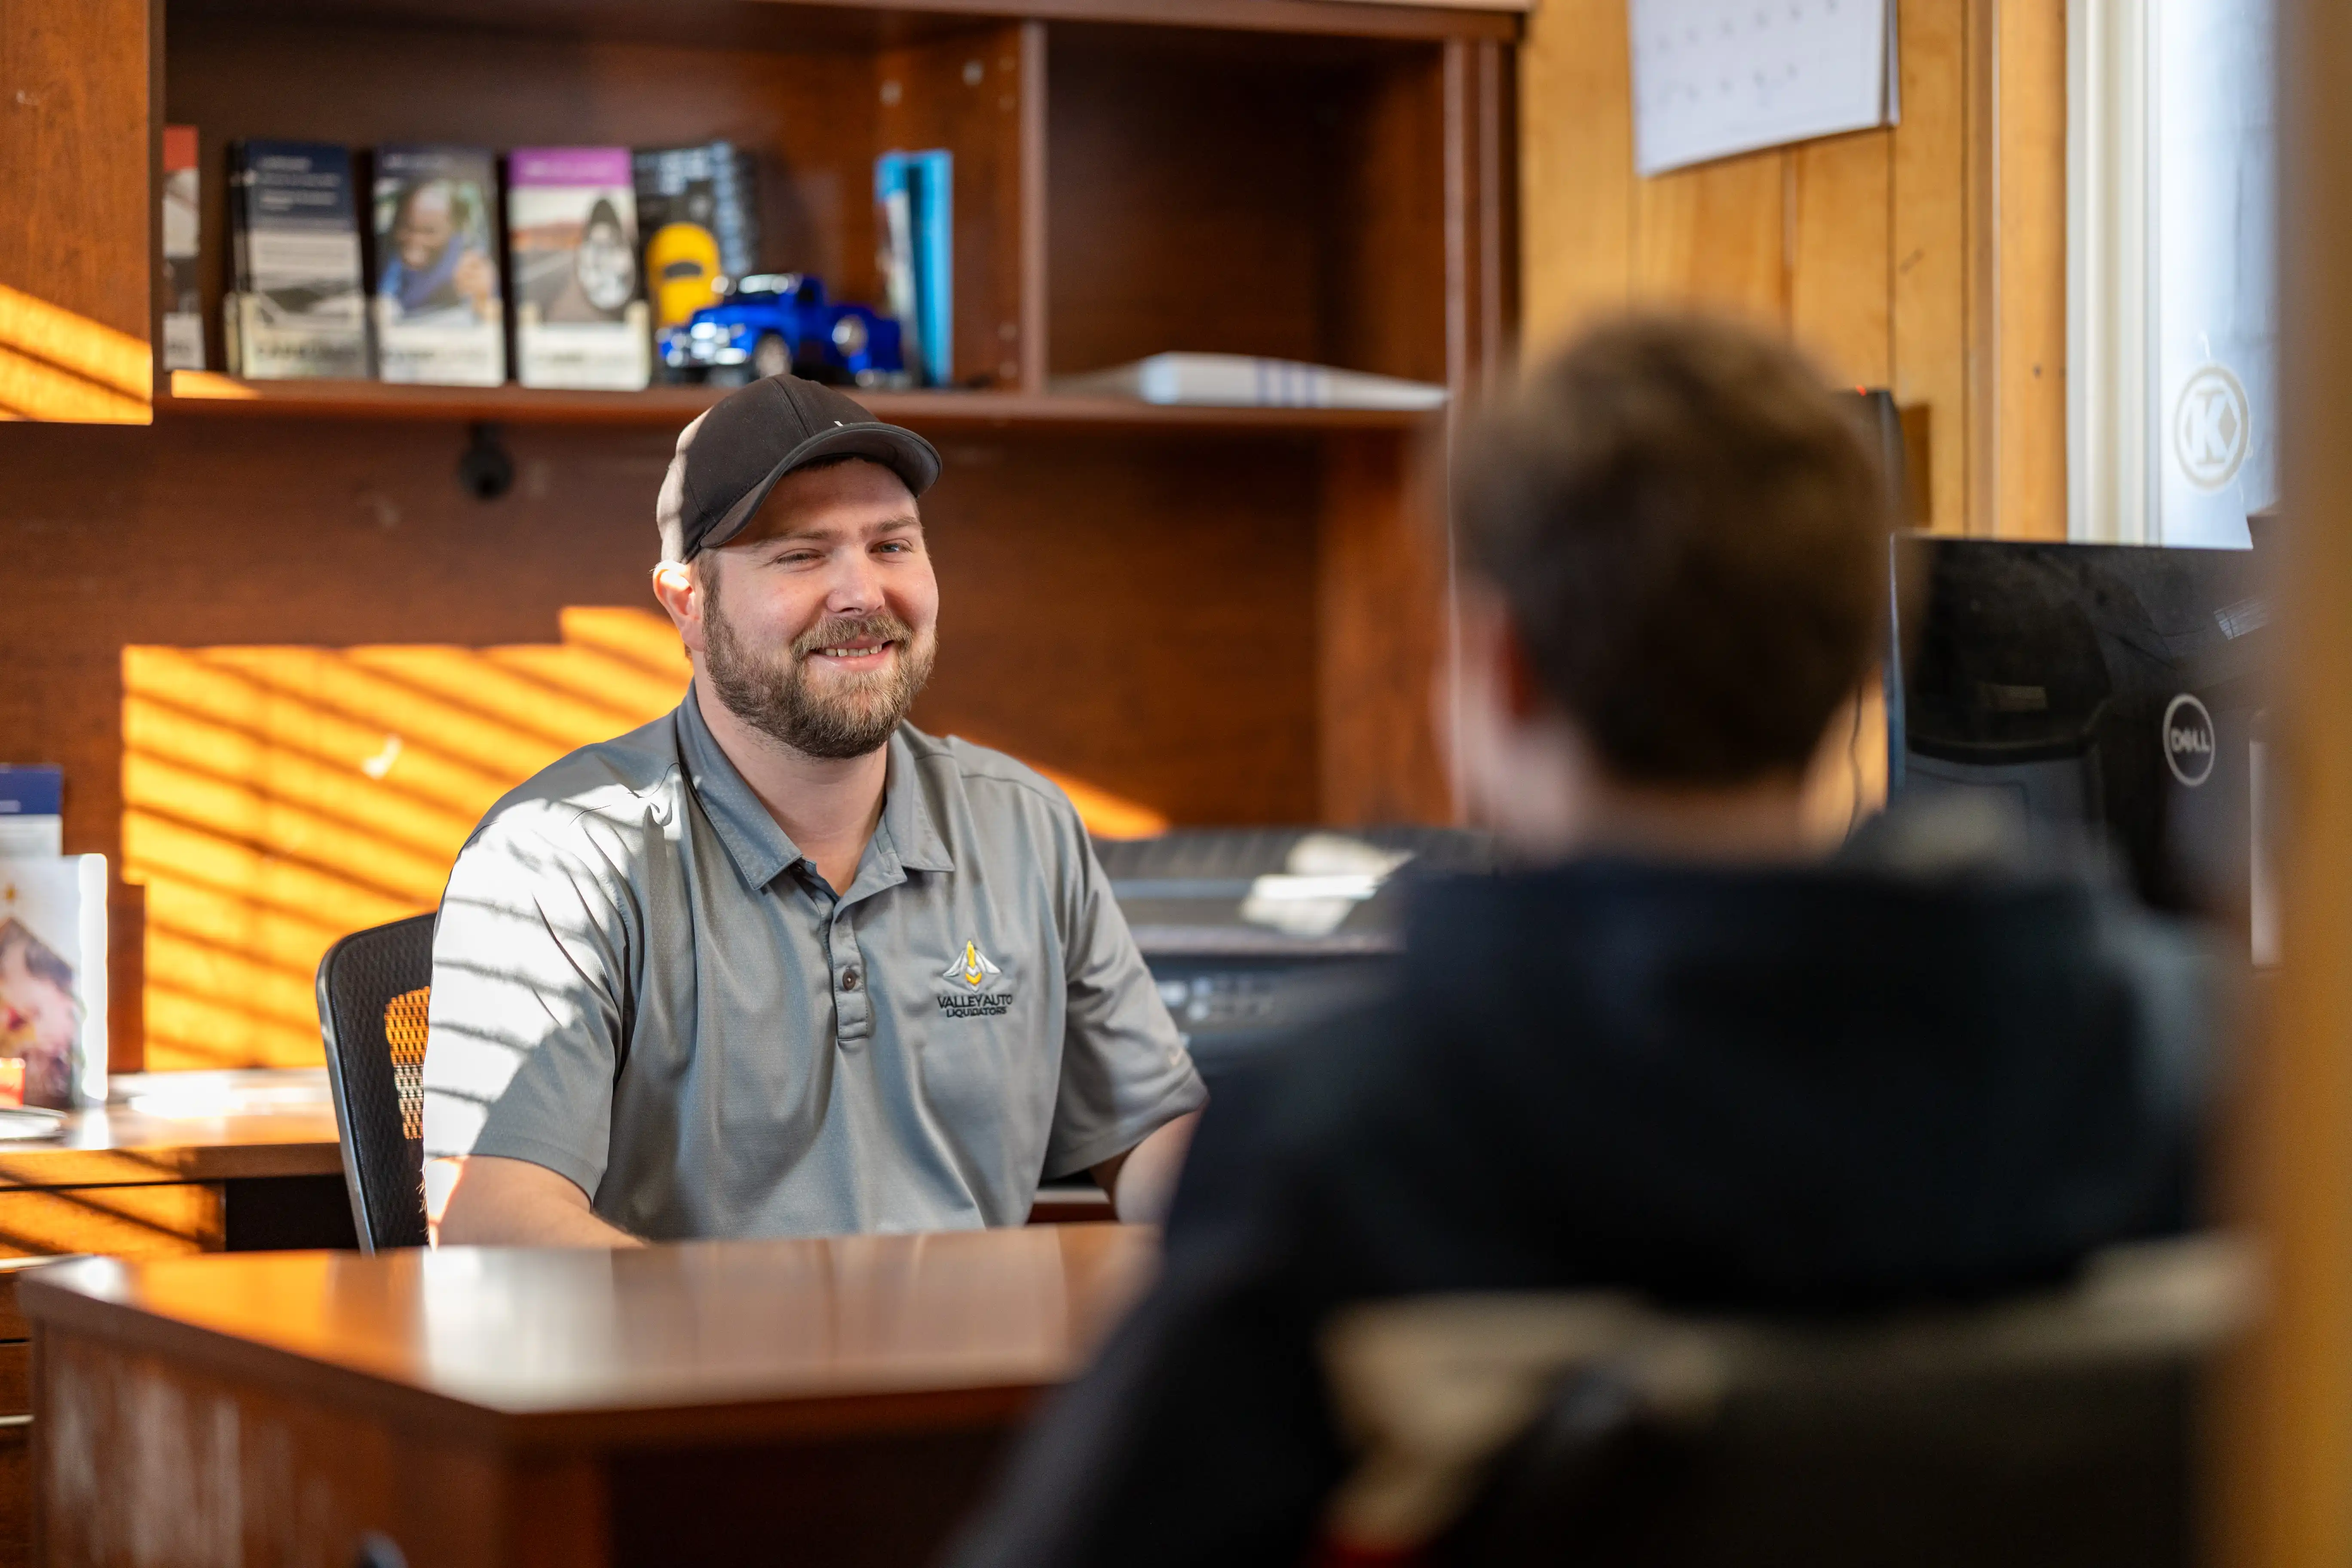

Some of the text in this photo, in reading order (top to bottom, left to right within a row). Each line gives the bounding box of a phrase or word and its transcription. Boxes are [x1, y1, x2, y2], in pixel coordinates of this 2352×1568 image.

[2171, 728, 2211, 753] DELL
[937, 993, 1013, 1009] VALLEY AUTO
[946, 1006, 1007, 1018] LIQUIDATORS
